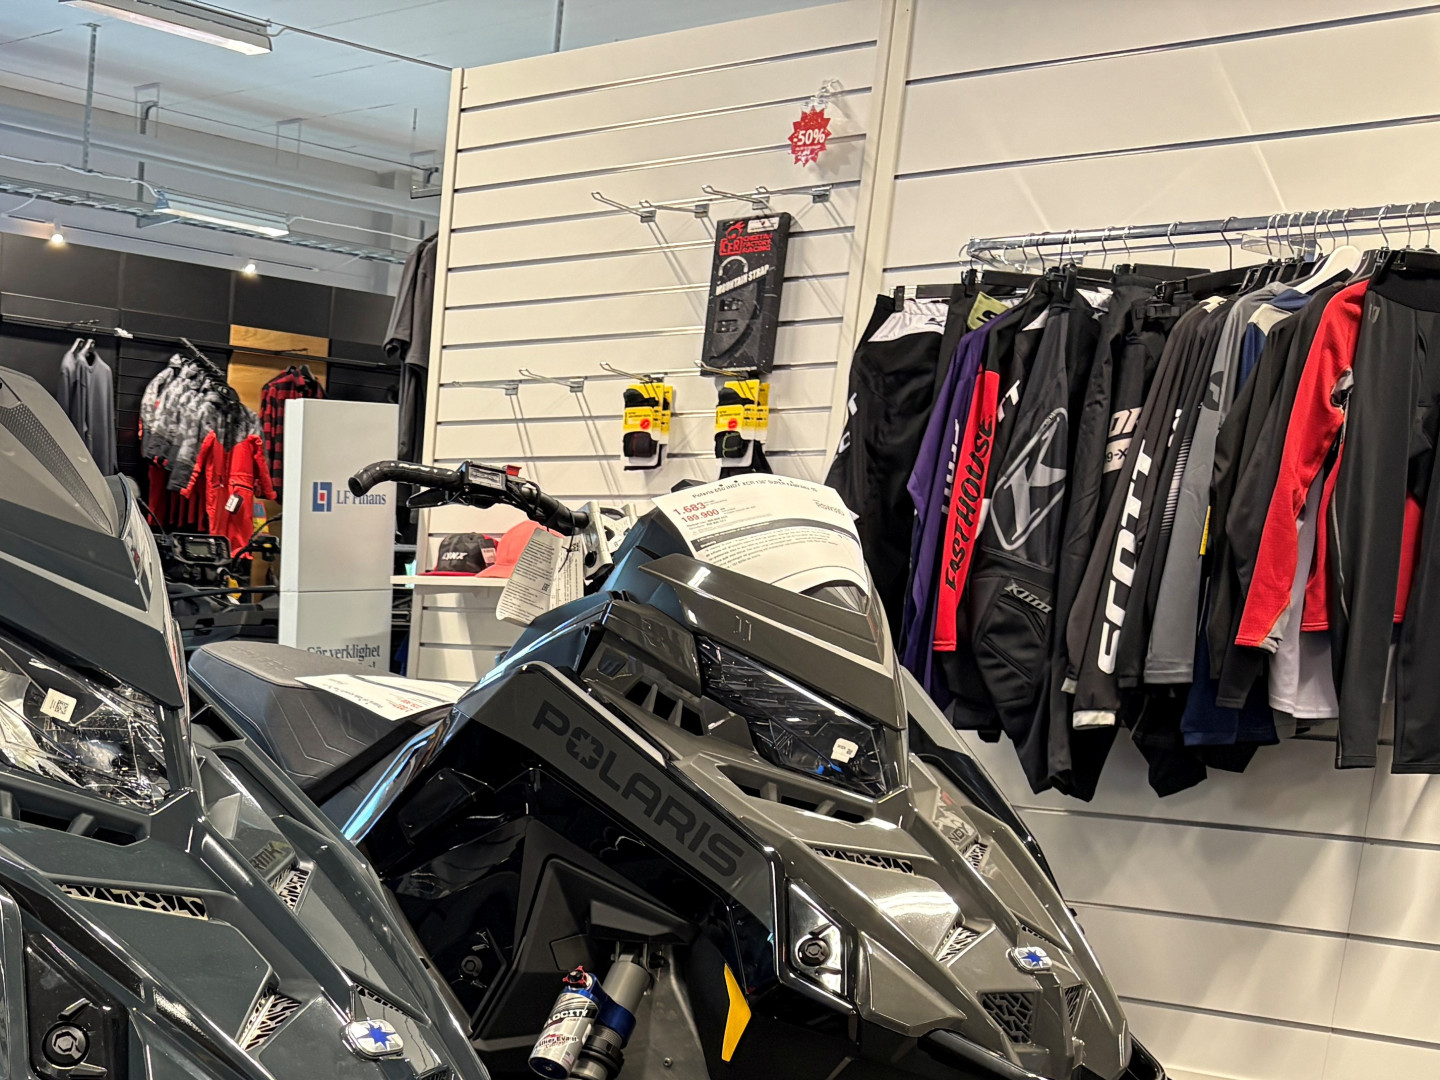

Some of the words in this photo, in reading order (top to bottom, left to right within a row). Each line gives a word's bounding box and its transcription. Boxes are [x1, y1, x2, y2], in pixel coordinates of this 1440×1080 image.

[793, 128, 826, 146] -50%
[715, 272, 748, 296] MOUNTAIN
[747, 264, 770, 281] STRAP
[336, 490, 351, 504] LF
[944, 414, 996, 592] FASTHOUSE
[673, 501, 707, 516] 1.683
[681, 508, 720, 523] 189.900
[441, 551, 468, 561] LYNX
[1097, 438, 1154, 675] SCOTT
[329, 643, 381, 662] verklighet
[531, 700, 751, 880] POLARIS
[948, 822, 969, 844] NDY
